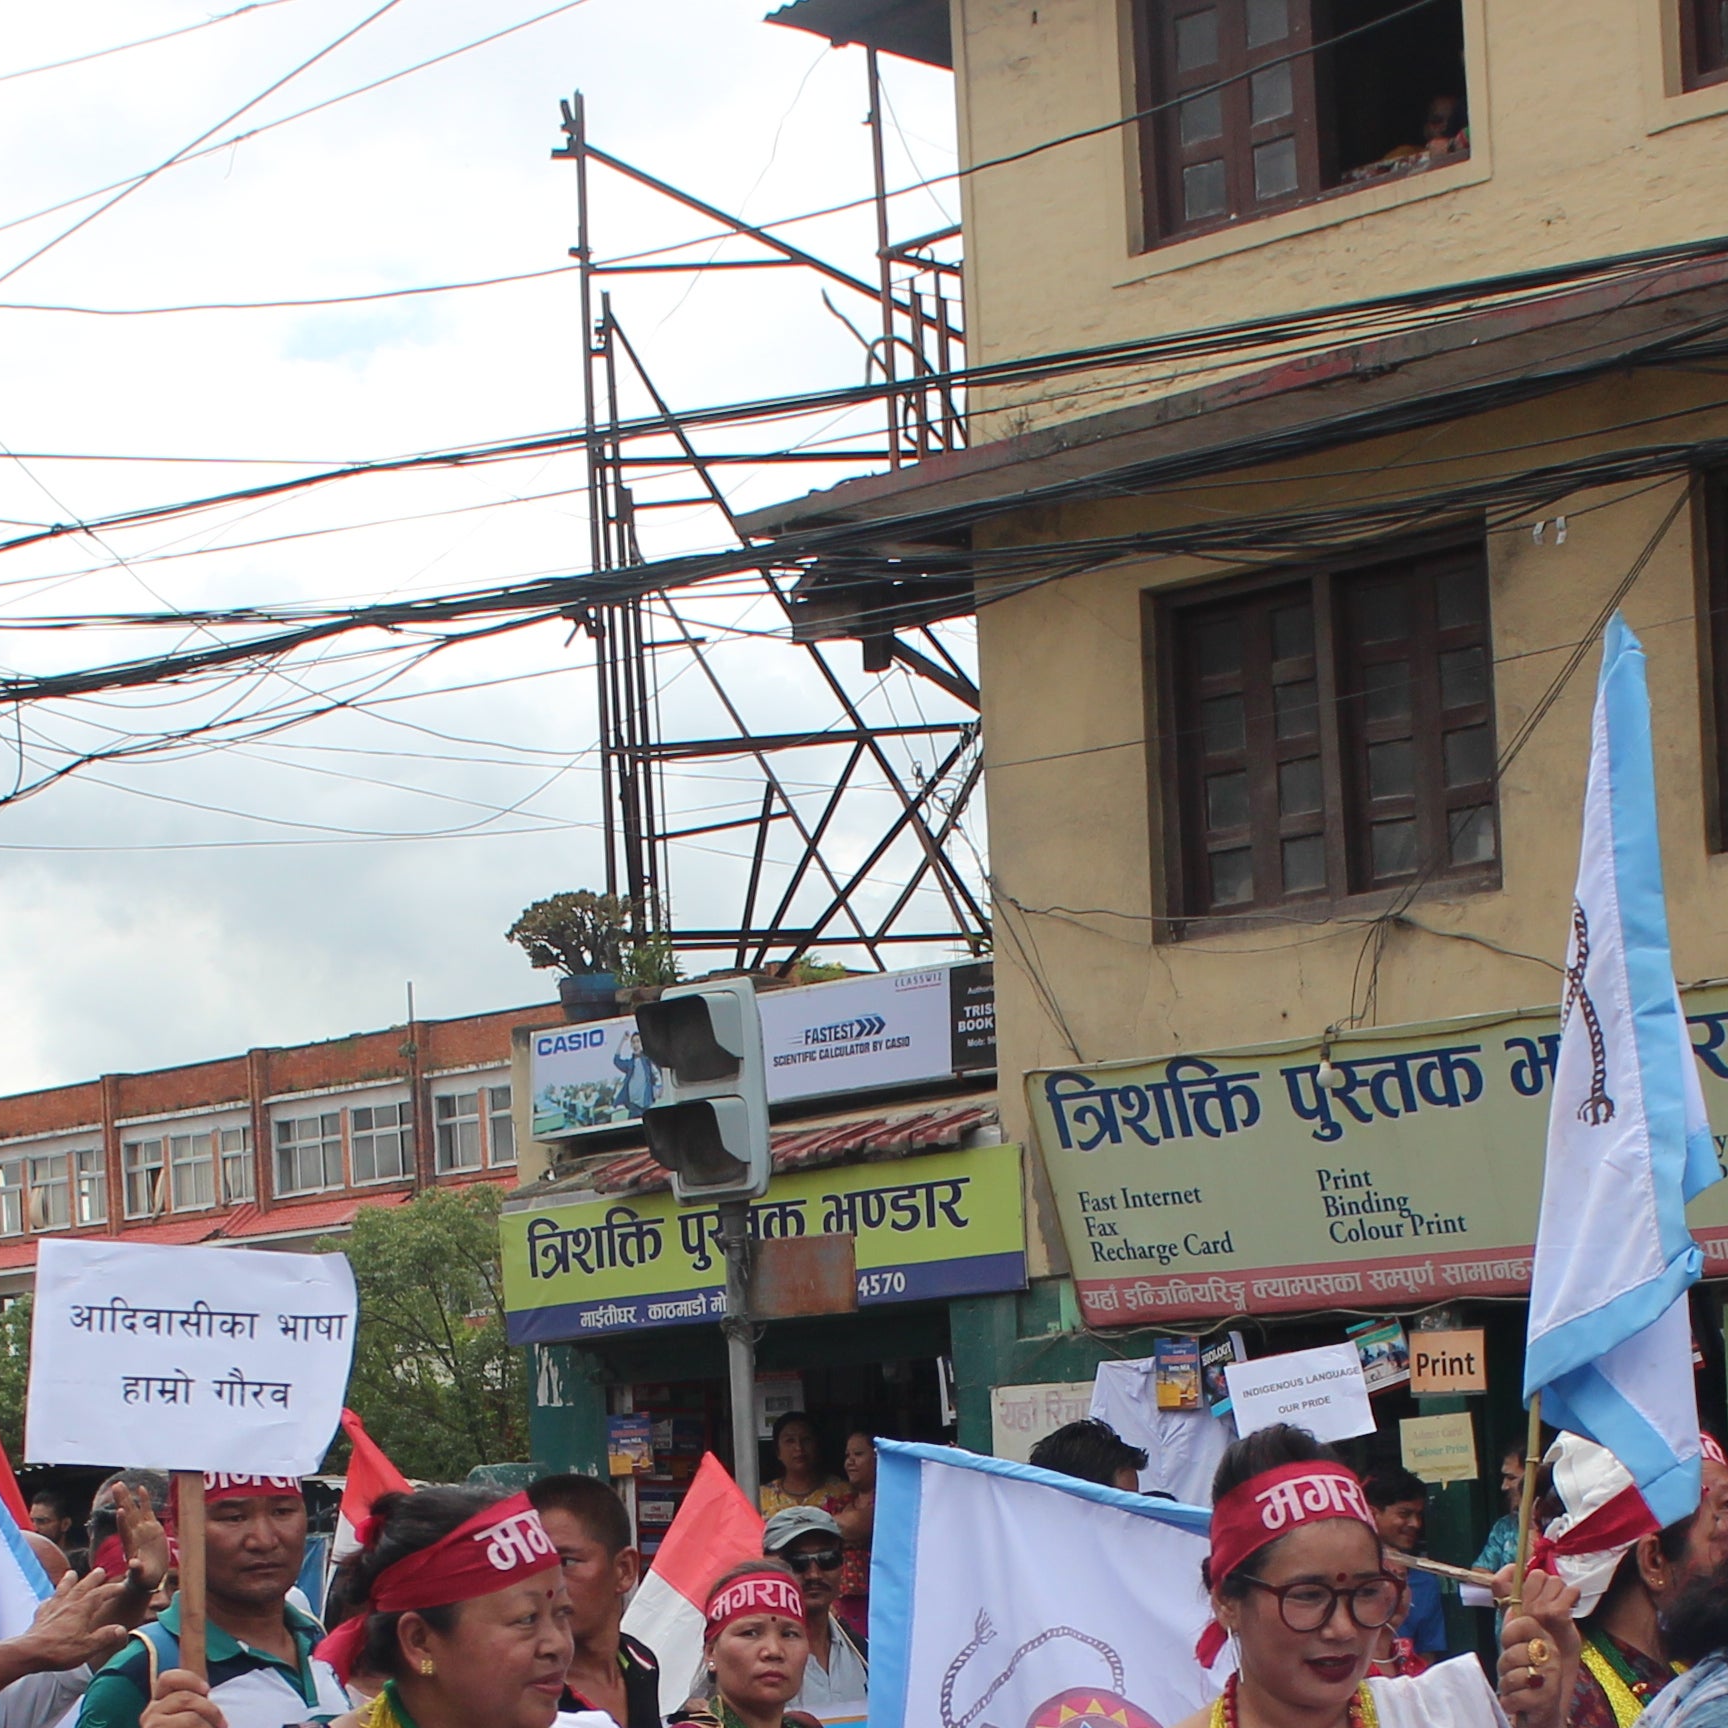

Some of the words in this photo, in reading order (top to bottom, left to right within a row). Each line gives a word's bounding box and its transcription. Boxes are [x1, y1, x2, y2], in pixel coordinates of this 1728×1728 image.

[536, 1028, 605, 1057] CASIO
[804, 1021, 855, 1045] FASTEST
[773, 1050, 817, 1067] SCIENTIFIC
[819, 1042, 870, 1061] CALCULATOR
[872, 1041, 883, 1052] BY
[885, 1036, 910, 1050] CASIO
[1045, 1057, 1261, 1152] त्रिशक्ति
[1281, 1044, 1483, 1144] पुस्तक
[1316, 1167, 1373, 1191] Print
[1078, 1190, 1116, 1214] Fast
[1120, 1186, 1202, 1211] Internet
[1323, 1191, 1411, 1219] Binding
[527, 1206, 664, 1279] त्रिशक्ति
[1084, 1216, 1118, 1240] Fax
[1329, 1219, 1406, 1245] Colour
[1411, 1213, 1467, 1237] Print
[1091, 1240, 1179, 1266] Recharge
[1183, 1231, 1234, 1257] Card
[1252, 1271, 1363, 1301] क्याम्पसका
[1367, 1260, 1435, 1294] सम्पूर्ण
[70, 1297, 259, 1340] आदिवासीका
[278, 1313, 348, 1341] भाषा
[1416, 1351, 1476, 1377] Print
[122, 1368, 195, 1405] हाम्रो
[213, 1368, 292, 1409] गौरव
[1242, 1377, 1304, 1399] INDIGENOUS
[1305, 1366, 1361, 1387] LANGUAGE
[1278, 1402, 1299, 1415] OUR
[1301, 1395, 1332, 1412] PRIDE
[711, 1579, 803, 1621] मगरात
